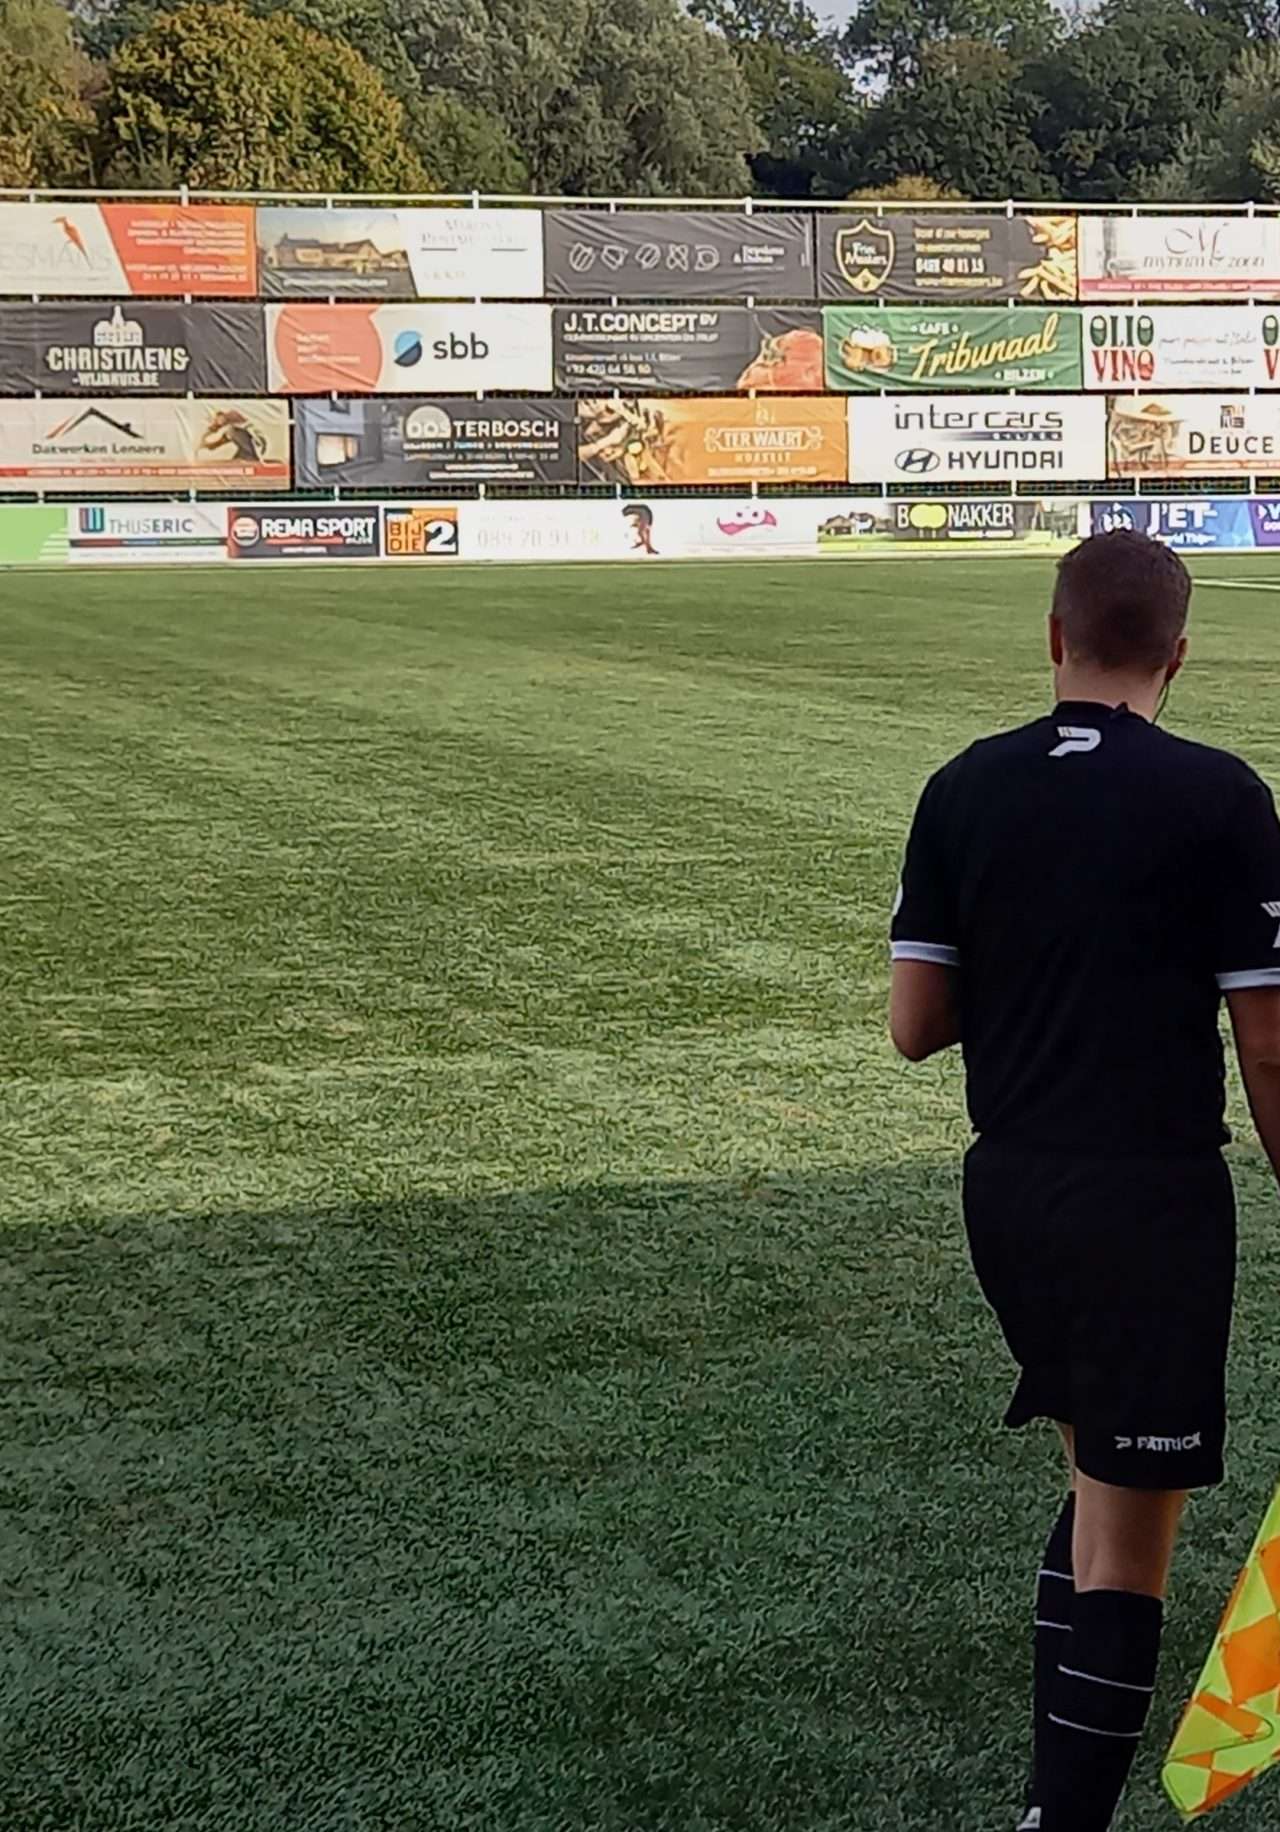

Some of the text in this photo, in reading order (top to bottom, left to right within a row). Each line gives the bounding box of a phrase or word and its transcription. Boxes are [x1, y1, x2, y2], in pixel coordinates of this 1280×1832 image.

[1089, 314, 1154, 347] OLIO
[432, 331, 489, 360] sbb
[908, 312, 1059, 382] Tribunaal
[49, 346, 187, 371] CHRISTIAENS
[1091, 349, 1155, 382] VINO
[895, 403, 1063, 429] intercars
[408, 420, 560, 438] OOSTERBOSCH
[32, 443, 108, 455] Dakwerken
[948, 450, 1064, 469] HYUNDAI
[261, 516, 376, 538] REMA SPORT
[1136, 1431, 1202, 1452] PATRICK
